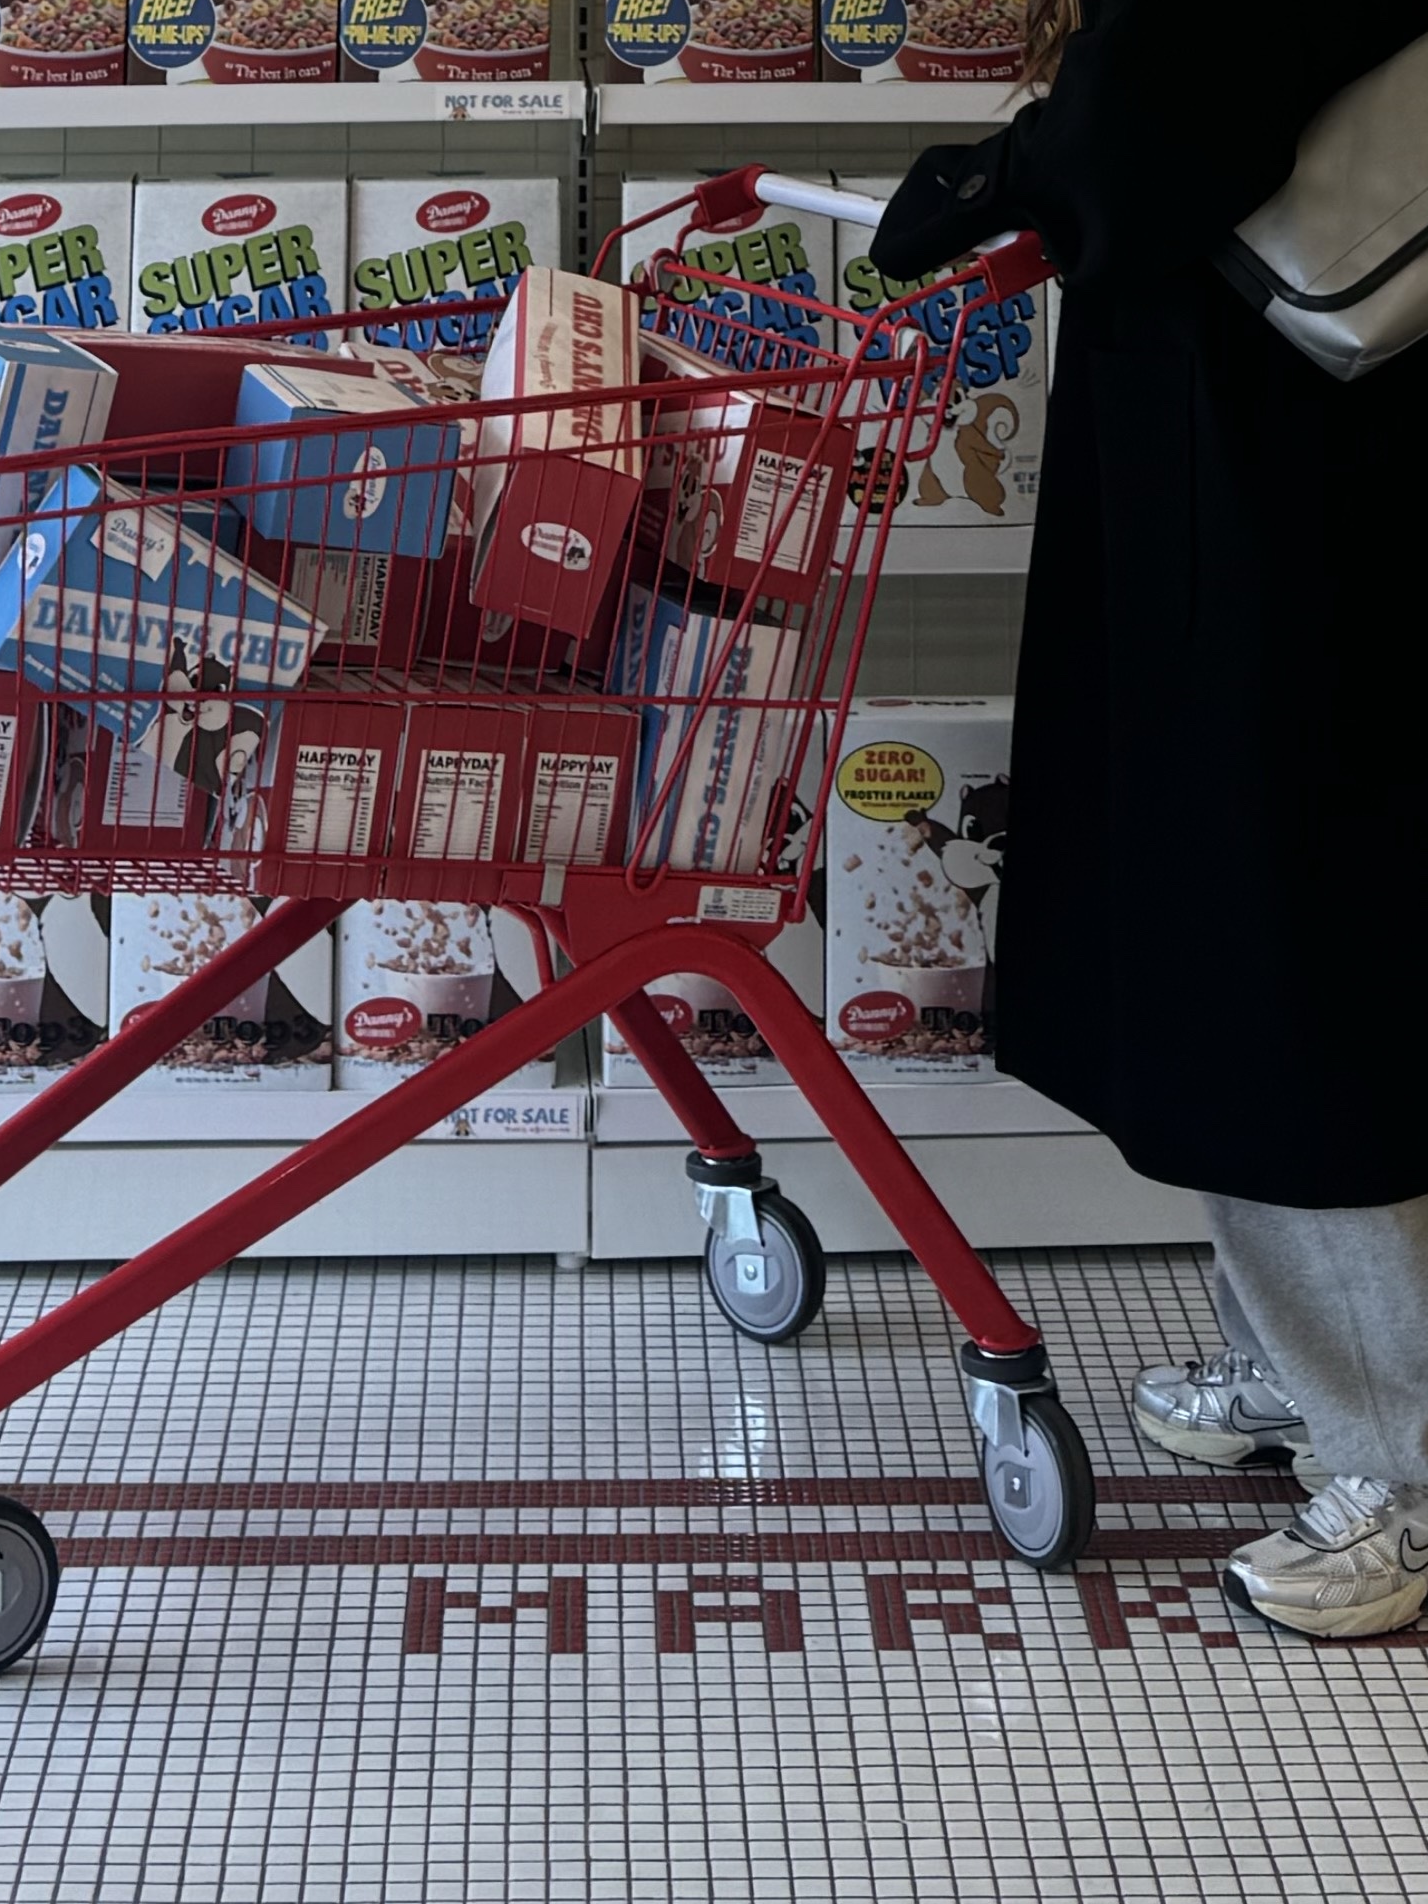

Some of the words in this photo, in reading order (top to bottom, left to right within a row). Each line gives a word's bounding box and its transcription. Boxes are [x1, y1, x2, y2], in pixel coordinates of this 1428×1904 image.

[444, 94, 478, 109] NOT
[481, 94, 514, 109] FOR
[518, 94, 563, 109] SALE
[213, 199, 267, 224] Danny's
[426, 195, 480, 221] Danny's
[139, 225, 321, 318] SUPER
[355, 221, 535, 313] SUPER
[573, 292, 604, 340] CHU
[572, 339, 604, 443] DANY'S
[219, 629, 305, 672] CHU
[865, 750, 914, 767] ZERO
[855, 767, 925, 784] SUGAR!
[483, 1108, 518, 1124] FOR
[521, 1108, 570, 1125] SALE
